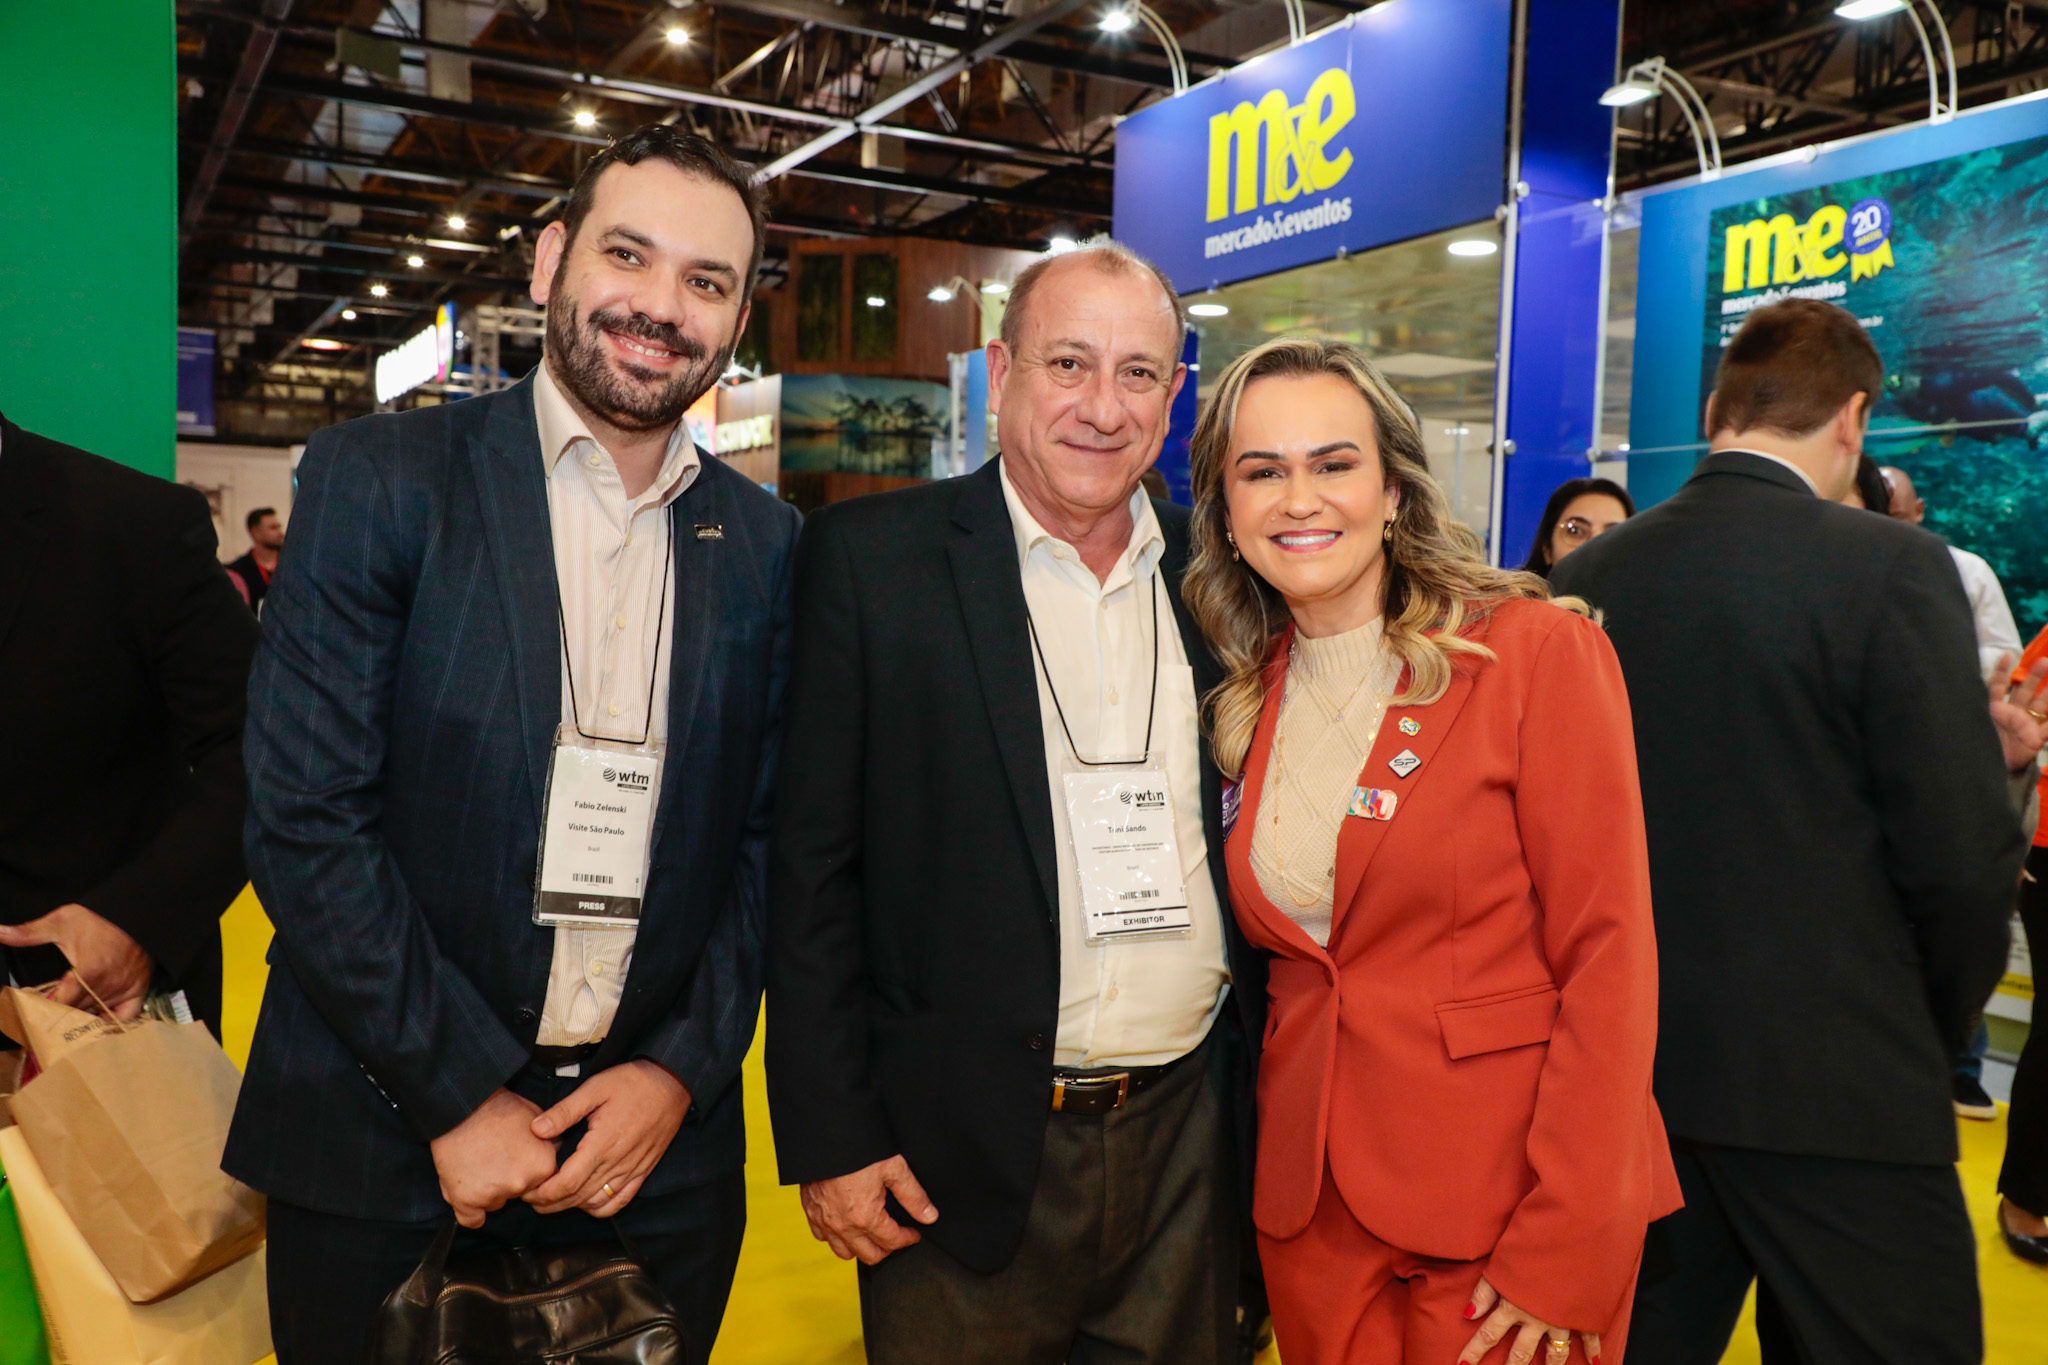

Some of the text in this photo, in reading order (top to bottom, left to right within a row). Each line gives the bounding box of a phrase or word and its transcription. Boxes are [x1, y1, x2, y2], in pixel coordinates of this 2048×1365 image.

[1206, 67, 1356, 223] m&e
[1204, 197, 1353, 259] mercado&eventos
[1851, 205, 1882, 238] 20
[1722, 204, 1849, 293] m&e
[619, 771, 649, 784] wtm
[574, 800, 627, 813] Fabio Zelenski
[568, 822, 588, 832] Visite
[604, 826, 625, 836] Paulo
[1125, 824, 1147, 833] Sando
[578, 901, 605, 911] PRESS
[1123, 915, 1165, 925] EXHIBITOR
